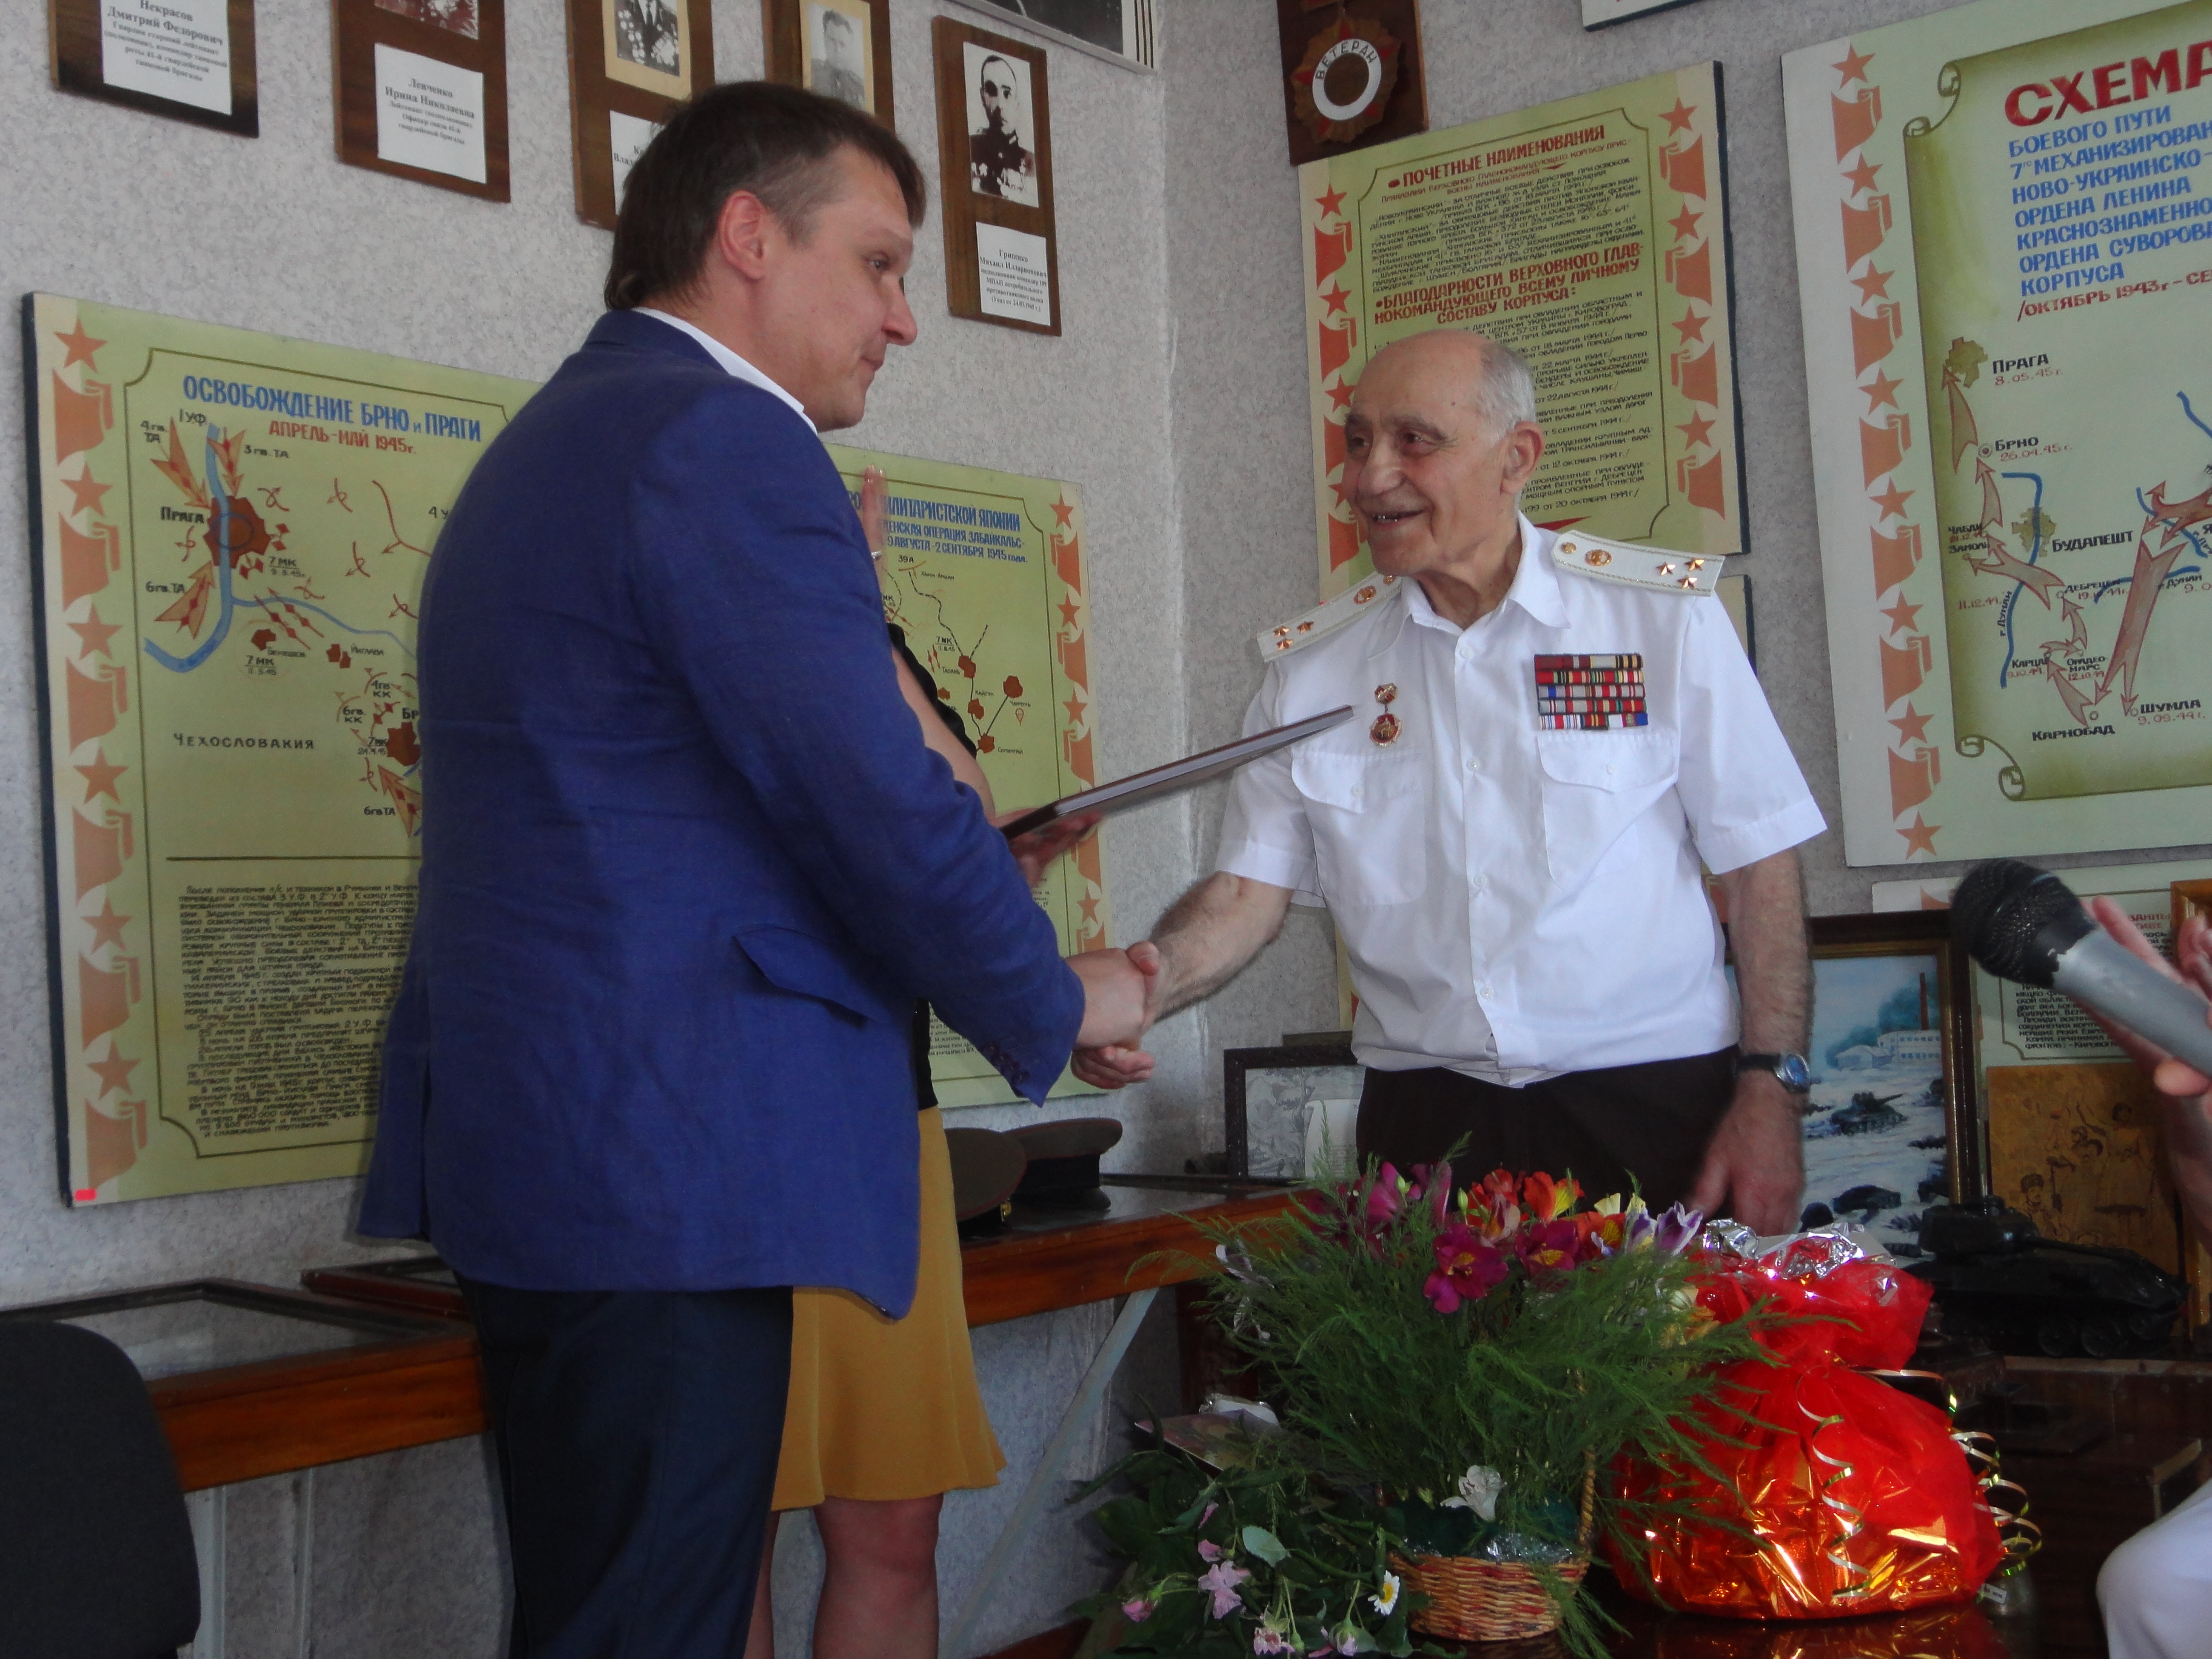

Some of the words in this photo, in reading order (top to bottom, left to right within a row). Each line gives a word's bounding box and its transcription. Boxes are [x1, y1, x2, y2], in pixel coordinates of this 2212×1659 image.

[107, 6, 160, 28] Дмитрий
[163, 21, 223, 45] Федорович
[1315, 40, 1377, 79] ВЕТЕРАН
[408, 78, 454, 98] Левченко
[2004, 40, 2212, 126] СХЕМА
[385, 86, 417, 103] Ирина
[420, 95, 475, 119] Николаевна
[2008, 120, 2107, 158] БОЕВОГО
[2114, 104, 2171, 133] ПУТИ
[1403, 155, 1480, 187] ПОЧЕТНЫЕ
[1487, 124, 1604, 167] НАИМЕНОВАНИЯ
[2034, 119, 2212, 175] МЕХАНИЗИРОВАН
[2014, 196, 2095, 227] ОРДЕНА
[2103, 175, 2191, 210] ЛЕНИНА
[980, 256, 1004, 267] Михаил
[1005, 262, 1047, 278] Илларионович
[2019, 243, 2099, 273] ОРДЕНА
[1384, 271, 1503, 310] БЛАГОДАРНОСТИ
[1509, 250, 1598, 283] ВЕРХОВНОГО
[2020, 261, 2124, 297] КОРПУСА
[1375, 284, 1511, 324] НОКОМАНДУЮЩЕГО
[1518, 273, 1565, 295] ВСЕМУ
[1570, 258, 1639, 284] ЛИЧНОМУ
[1436, 301, 1497, 325] СОСТАВУ
[1472, 317, 1513, 331] ДЕЙСТВИЯ
[1516, 313, 1530, 321] ПРИ
[1533, 303, 1579, 318] ОВЛАДЕНИИ
[1582, 292, 1632, 308] ОБЛАСТНЫМ
[1488, 321, 1523, 334] ЦЕНТРОМ
[1527, 312, 1566, 326] УКРАИНЫ
[1521, 331, 1538, 341] ПРИ
[1541, 321, 1589, 337] ОВЛАДЕНИИ
[1592, 313, 1632, 327] ГОРОДАМИ
[1549, 317, 1580, 328] ЯНВАРЯ
[1554, 336, 1580, 347] МАРТА
[1587, 335, 1622, 347] ГОРОДОМ
[1554, 356, 1580, 367] МАРТА
[1575, 358, 1604, 370] СИЛЬНО
[1583, 357, 1649, 375] ОСВОБОЖДЕНИЕ
[1992, 354, 2048, 374] ПРАГА
[183, 375, 354, 424] ОСВОБОЖДЕНИЕ
[360, 402, 409, 432] БРНО
[424, 412, 481, 443] ПРАГИ
[1555, 409, 1591, 421] ВАЖНЫМ
[1595, 403, 1621, 414] УЗЛОМ
[1545, 435, 1591, 449] ОВЛАДЕНИИ
[1595, 428, 1634, 441] КРУПНЫМ
[1994, 437, 2039, 451] БРНО
[1563, 455, 1597, 467] ОКТЯБРЯ
[1526, 488, 1563, 501] МОЩНЫМ
[1564, 481, 1604, 494] ОПОРНЫМ
[1607, 475, 1644, 487] ПУНКТОМ
[1530, 470, 1590, 486] ПРОЯВЛЕННЫЕ
[1555, 477, 1591, 488] ВЕНГРИИ
[1569, 494, 1606, 506] ОКТЯБРЯ
[160, 506, 204, 523] ПРАГА
[882, 495, 976, 526] ИЛИТАРИСТСКОЙ
[978, 508, 1020, 531] ЯПОНИИ
[923, 525, 966, 542] ОПЕРАЦИЯ
[2051, 530, 2133, 552] БУДАПЕШТ
[941, 541, 984, 558] СЕНТЯБРЯ
[2139, 698, 2202, 714] ШУМЛА
[173, 732, 313, 749] ЧЕХОСЛОВАКИЯ
[2032, 724, 2116, 742] КАРНОБАД
